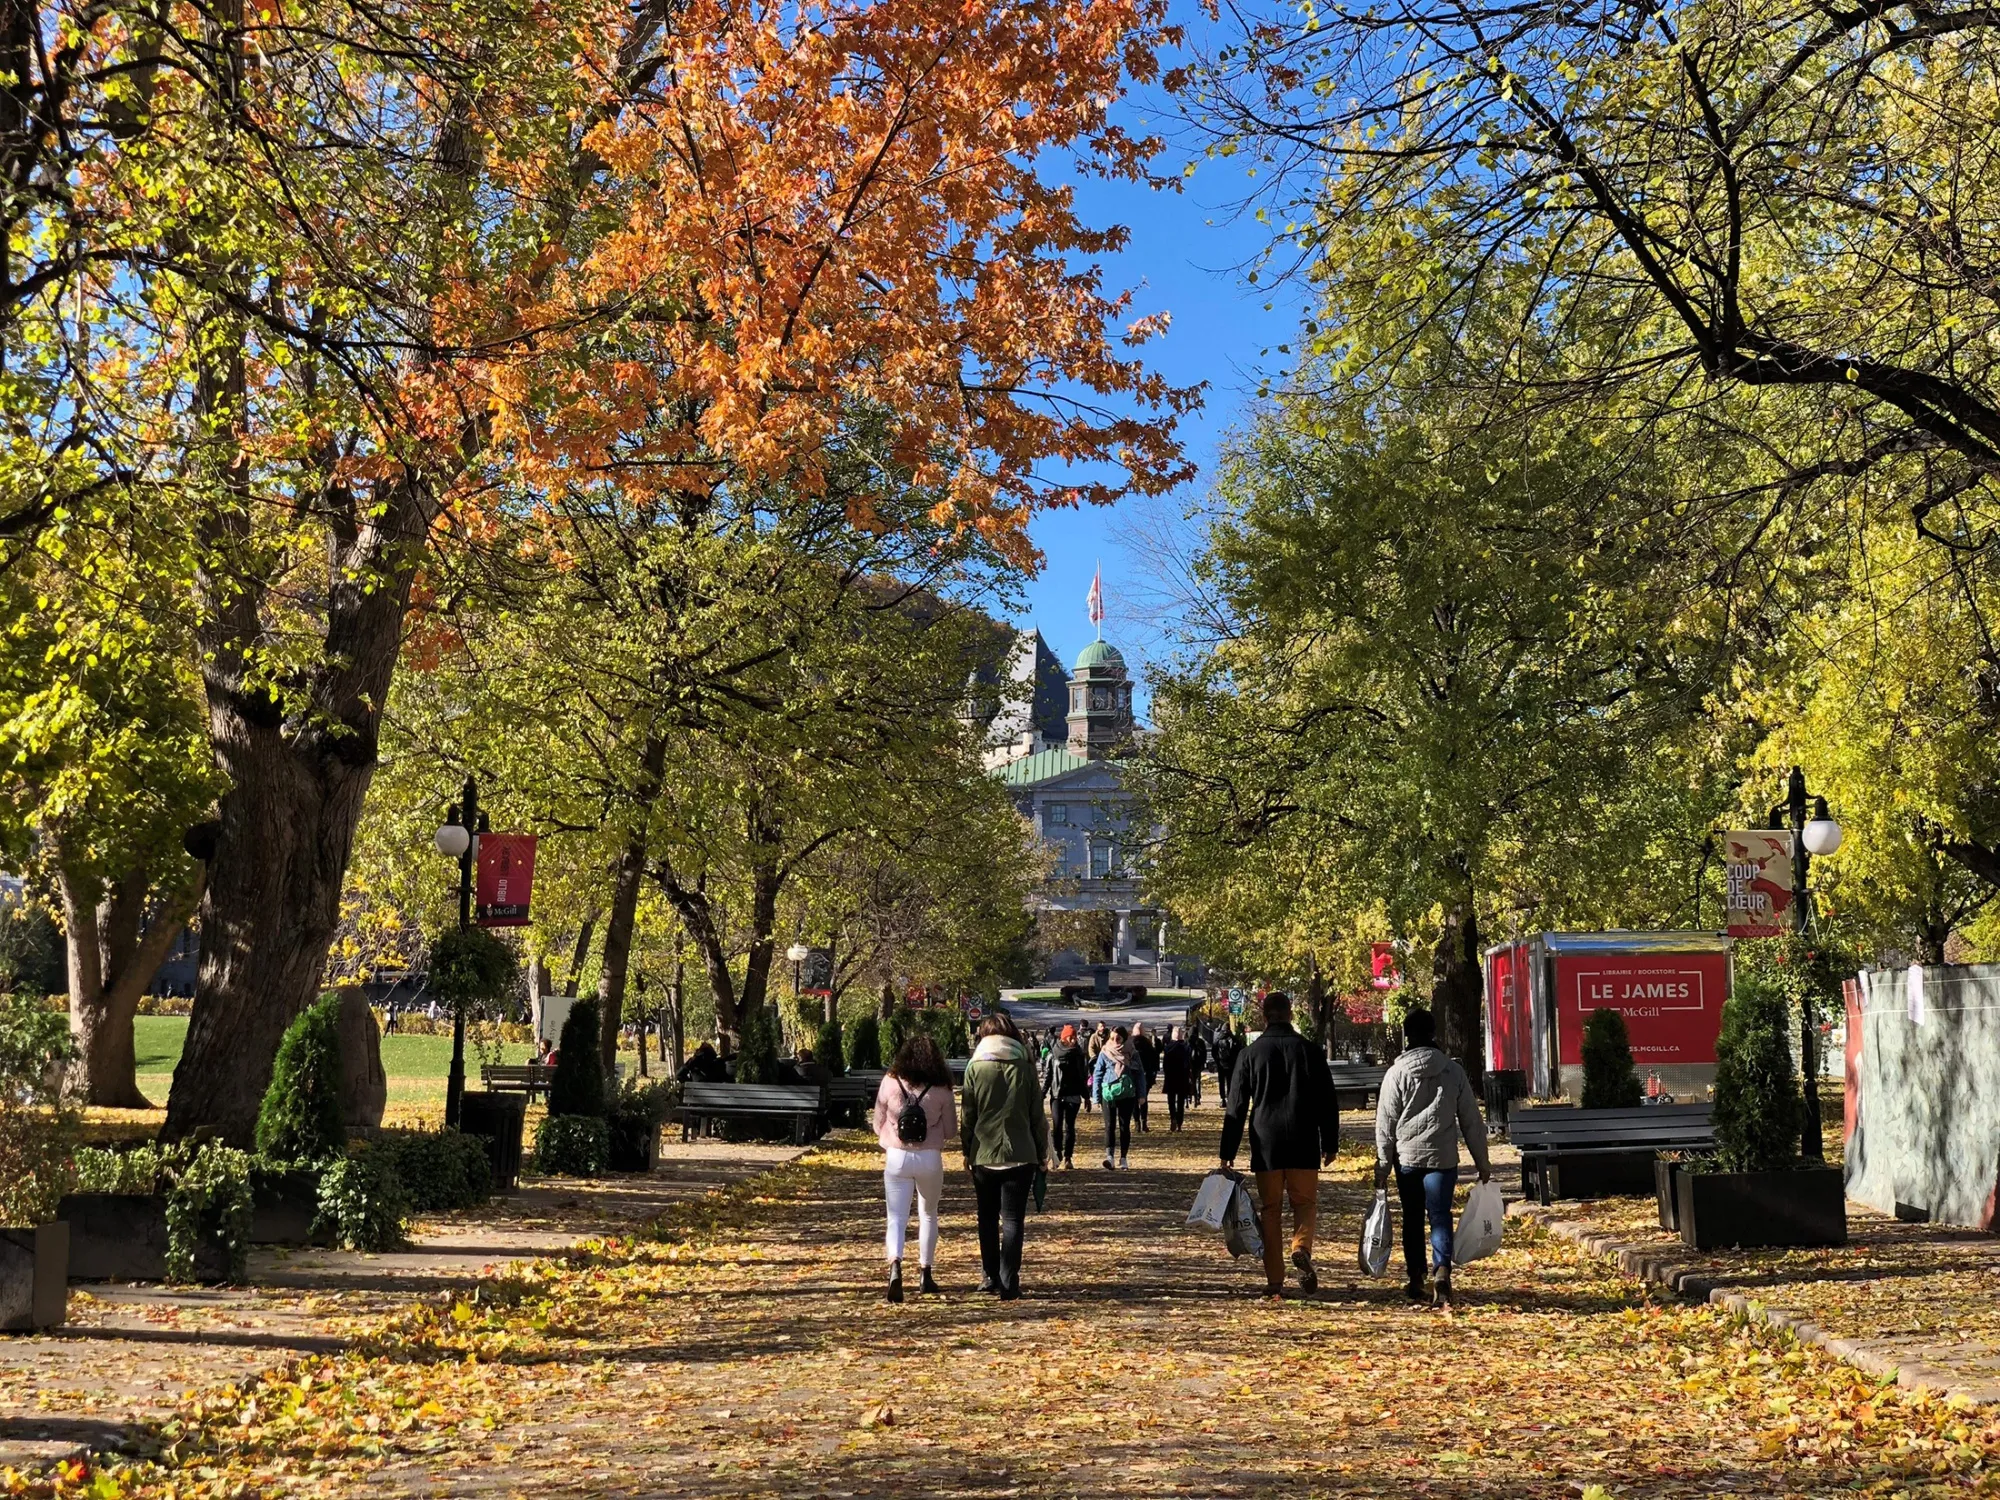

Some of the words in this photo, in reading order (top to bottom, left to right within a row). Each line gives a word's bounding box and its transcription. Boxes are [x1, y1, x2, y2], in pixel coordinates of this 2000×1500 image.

[1727, 864, 1760, 879] COUP
[497, 879, 508, 902] BIBLIO
[1727, 880, 1743, 894] DE
[1727, 894, 1765, 909] CŒUR
[494, 906, 517, 915] McGill
[1591, 984, 1614, 999] LE
[1621, 983, 1689, 999] JAMES
[1623, 1006, 1659, 1017] McGill
